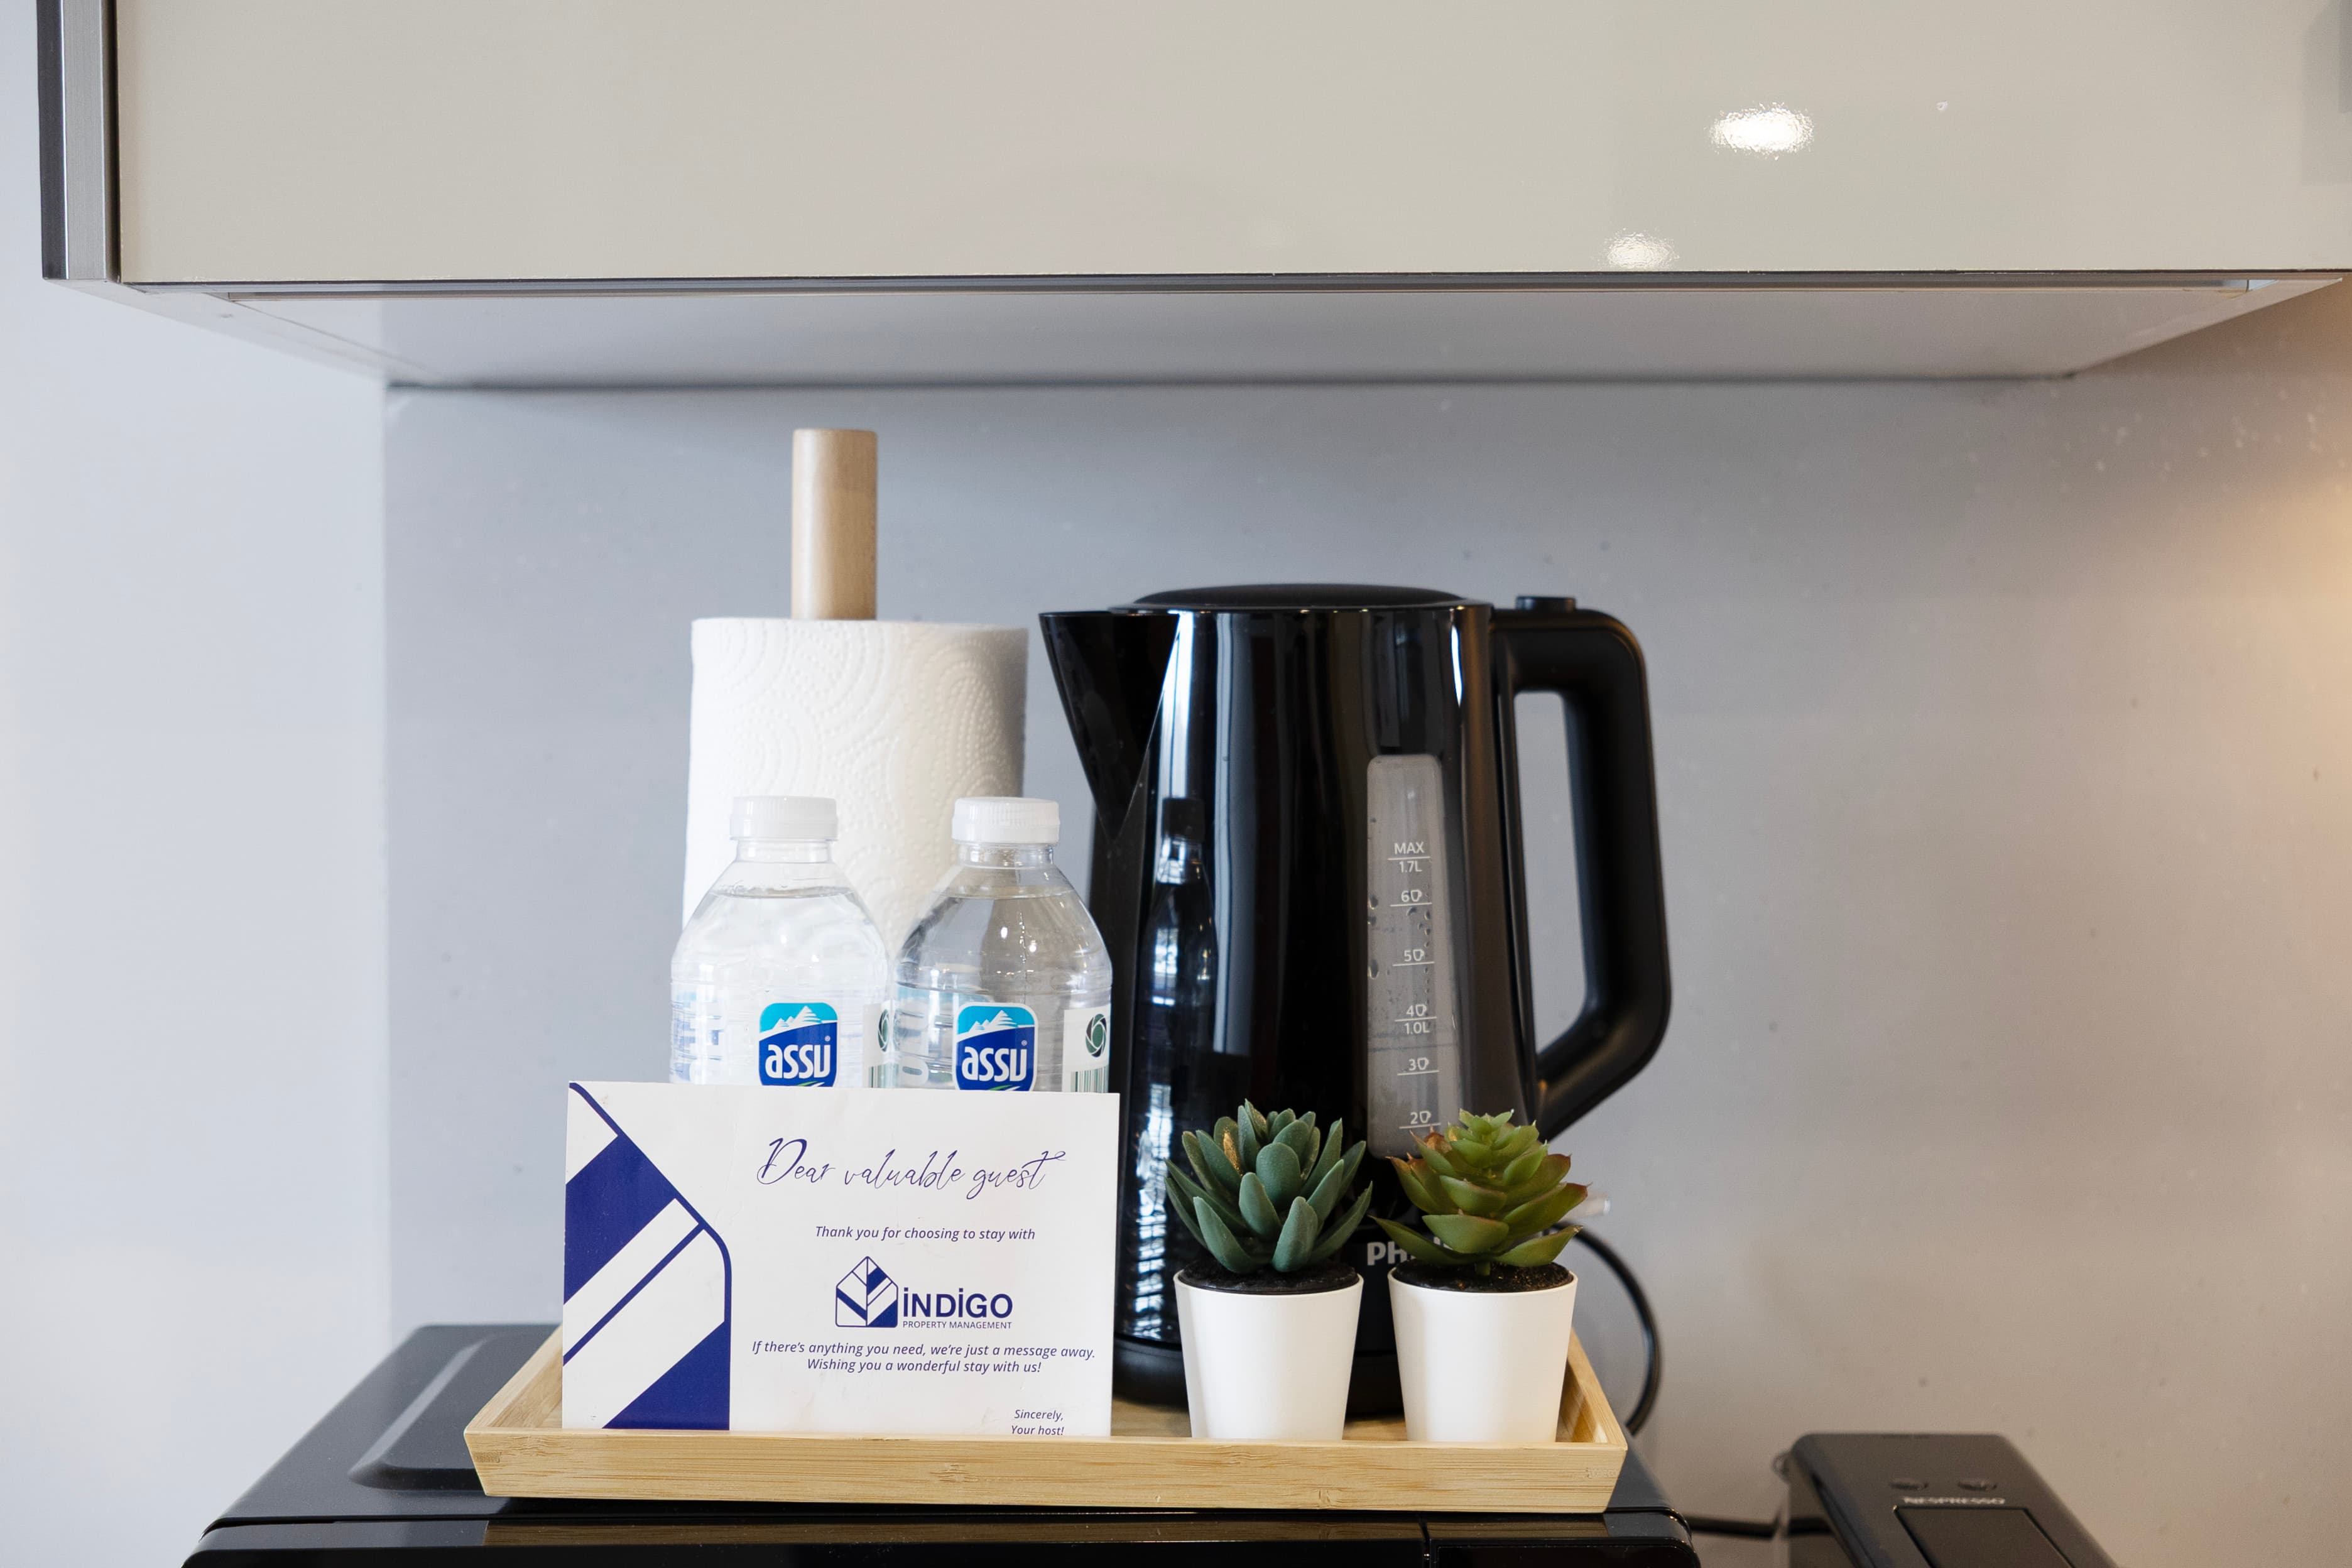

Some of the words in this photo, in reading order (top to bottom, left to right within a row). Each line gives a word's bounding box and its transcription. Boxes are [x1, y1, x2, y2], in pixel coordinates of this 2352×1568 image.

[1394, 842, 1425, 854] MAX
[1399, 861, 1422, 873] 1.7L
[1405, 1021, 1429, 1035] 1.0L
[765, 1044, 830, 1080] assu
[962, 1047, 1027, 1082] assu
[757, 1138, 836, 1184] Dear
[844, 1149, 966, 1190] valuable
[966, 1150, 1066, 1200] guest
[816, 1226, 853, 1238] Thank
[855, 1229, 879, 1241] you
[881, 1226, 901, 1242] for
[905, 1227, 961, 1243] choosing
[964, 1229, 976, 1239] to
[979, 1229, 1006, 1243] stay
[1010, 1228, 1035, 1240] with
[903, 1320, 947, 1329] PROPERTY
[949, 1321, 1012, 1329] MANAGEMENT
[752, 1341, 763, 1355] If
[808, 1342, 864, 1358] anything
[866, 1346, 890, 1358] you
[893, 1343, 926, 1357] need,
[964, 1344, 989, 1359] just
[993, 1348, 1001, 1356] a
[1004, 1348, 1057, 1360] message
[1060, 1349, 1095, 1361] away.
[808, 1358, 856, 1374] Wishing
[858, 1362, 882, 1374] you
[885, 1363, 893, 1371] a
[897, 1359, 961, 1375] wonderful
[964, 1361, 989, 1375] stay
[993, 1361, 1019, 1373] with
[1023, 1361, 1042, 1373] us!
[1014, 1409, 1064, 1422] Sincerely,
[1011, 1425, 1036, 1435] Your
[1038, 1425, 1064, 1436] host!
